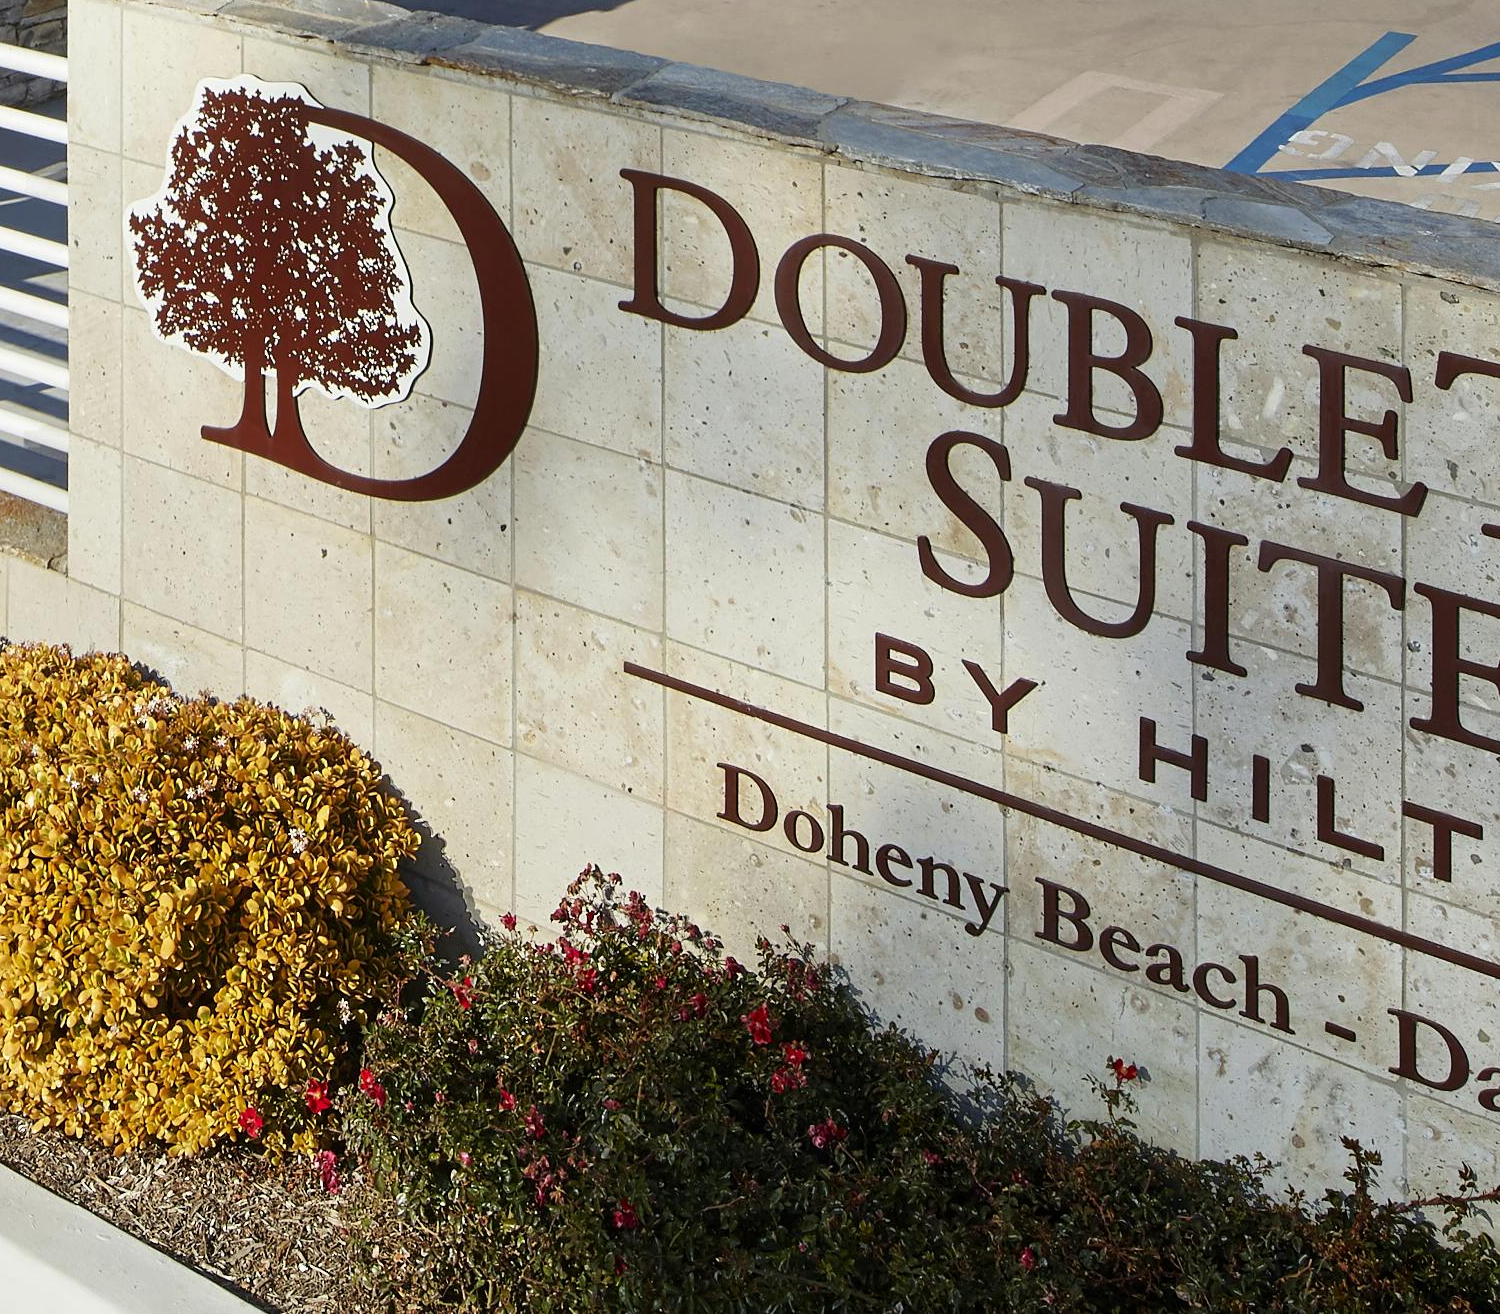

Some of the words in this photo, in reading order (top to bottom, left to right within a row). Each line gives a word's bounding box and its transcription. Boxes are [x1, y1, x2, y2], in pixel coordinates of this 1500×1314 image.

[875, 632, 1038, 735] BY
[715, 761, 1010, 937] Doheny
[1033, 876, 1296, 1036] Beach
[1324, 1020, 1356, 1043] -
